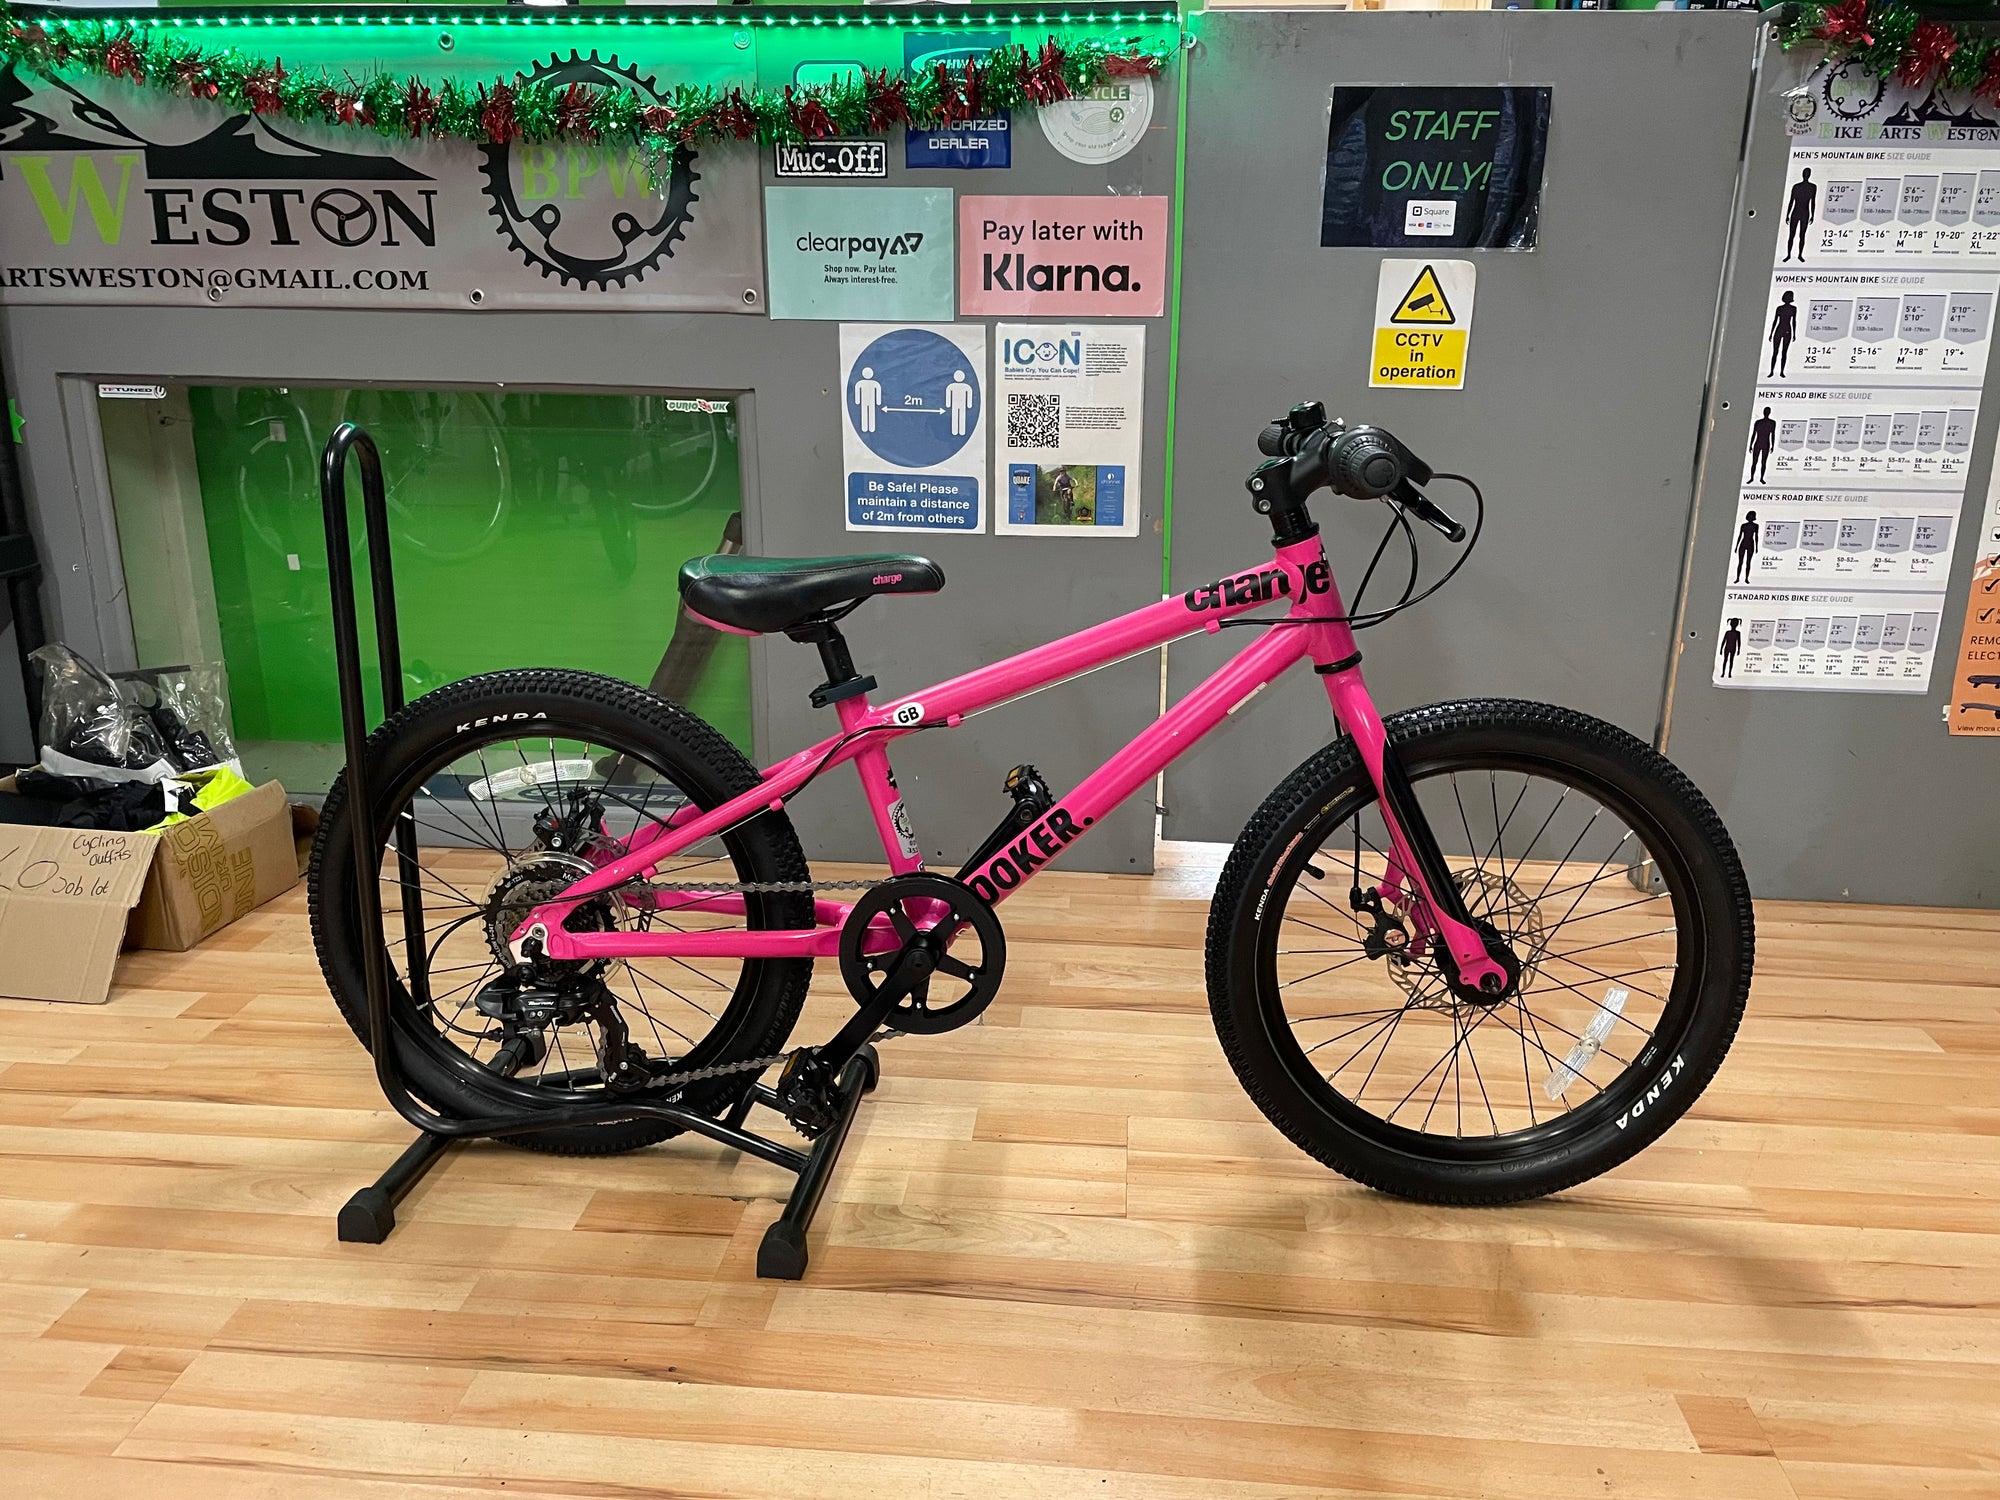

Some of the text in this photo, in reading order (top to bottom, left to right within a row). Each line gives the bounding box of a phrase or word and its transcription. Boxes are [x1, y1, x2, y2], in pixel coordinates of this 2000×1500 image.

[910, 119, 1008, 131] UTHORIZED
[1385, 110, 1500, 141] STAFF
[1819, 122, 1863, 139] BIKE
[1867, 122, 1922, 140] PARTS
[929, 138, 989, 149] DEALER
[781, 147, 882, 172] Muc-Off
[1793, 151, 1932, 160] MEN'S MOUNTAIN BIKE SIZE GUIDE
[1381, 160, 1493, 191] ONLY!
[10, 155, 438, 247] WESTON
[1423, 207, 1450, 216] Square
[983, 219, 1143, 245] Pay later with
[796, 232, 890, 260] clearpay
[1821, 239, 1833, 247] XS
[1858, 239, 1865, 247] S
[1896, 239, 1905, 247] M
[1933, 240, 1939, 248] L
[1970, 240, 1981, 249] XL
[824, 264, 843, 274] Shop
[863, 265, 876, 274] Pay
[879, 265, 897, 273] later.
[983, 253, 1141, 292] Klarna.
[824, 275, 898, 284] Always interest-free.
[1775, 275, 1814, 283] WOMEN'S
[1860, 276, 1879, 284] BIKE
[1881, 276, 1899, 284] SIZE
[1900, 276, 1925, 284] GUIDE
[1395, 333, 1443, 347] CCTV
[1409, 349, 1424, 362] in
[1850, 355, 1856, 363] S
[1896, 356, 1905, 364] M
[1942, 357, 1948, 365] L
[1380, 365, 1456, 380] operation
[904, 394, 923, 405] 2m
[1758, 391, 1783, 399] MEN'S
[1784, 391, 1806, 399] ROAD
[1848, 392, 1872, 400] GUIDE
[868, 481, 959, 494] Be Safe! Please
[857, 497, 907, 507] maintain
[920, 498, 970, 509] distance
[862, 511, 965, 524] of 2m from others
[873, 574, 902, 585] charge
[898, 707, 919, 723] GB
[456, 712, 547, 733] KENDA
[527, 786, 687, 803] SCALBE
[91, 876, 109, 896] lot
[1254, 888, 1270, 921] KENDA
[1615, 1053, 1685, 1130] KENDA
